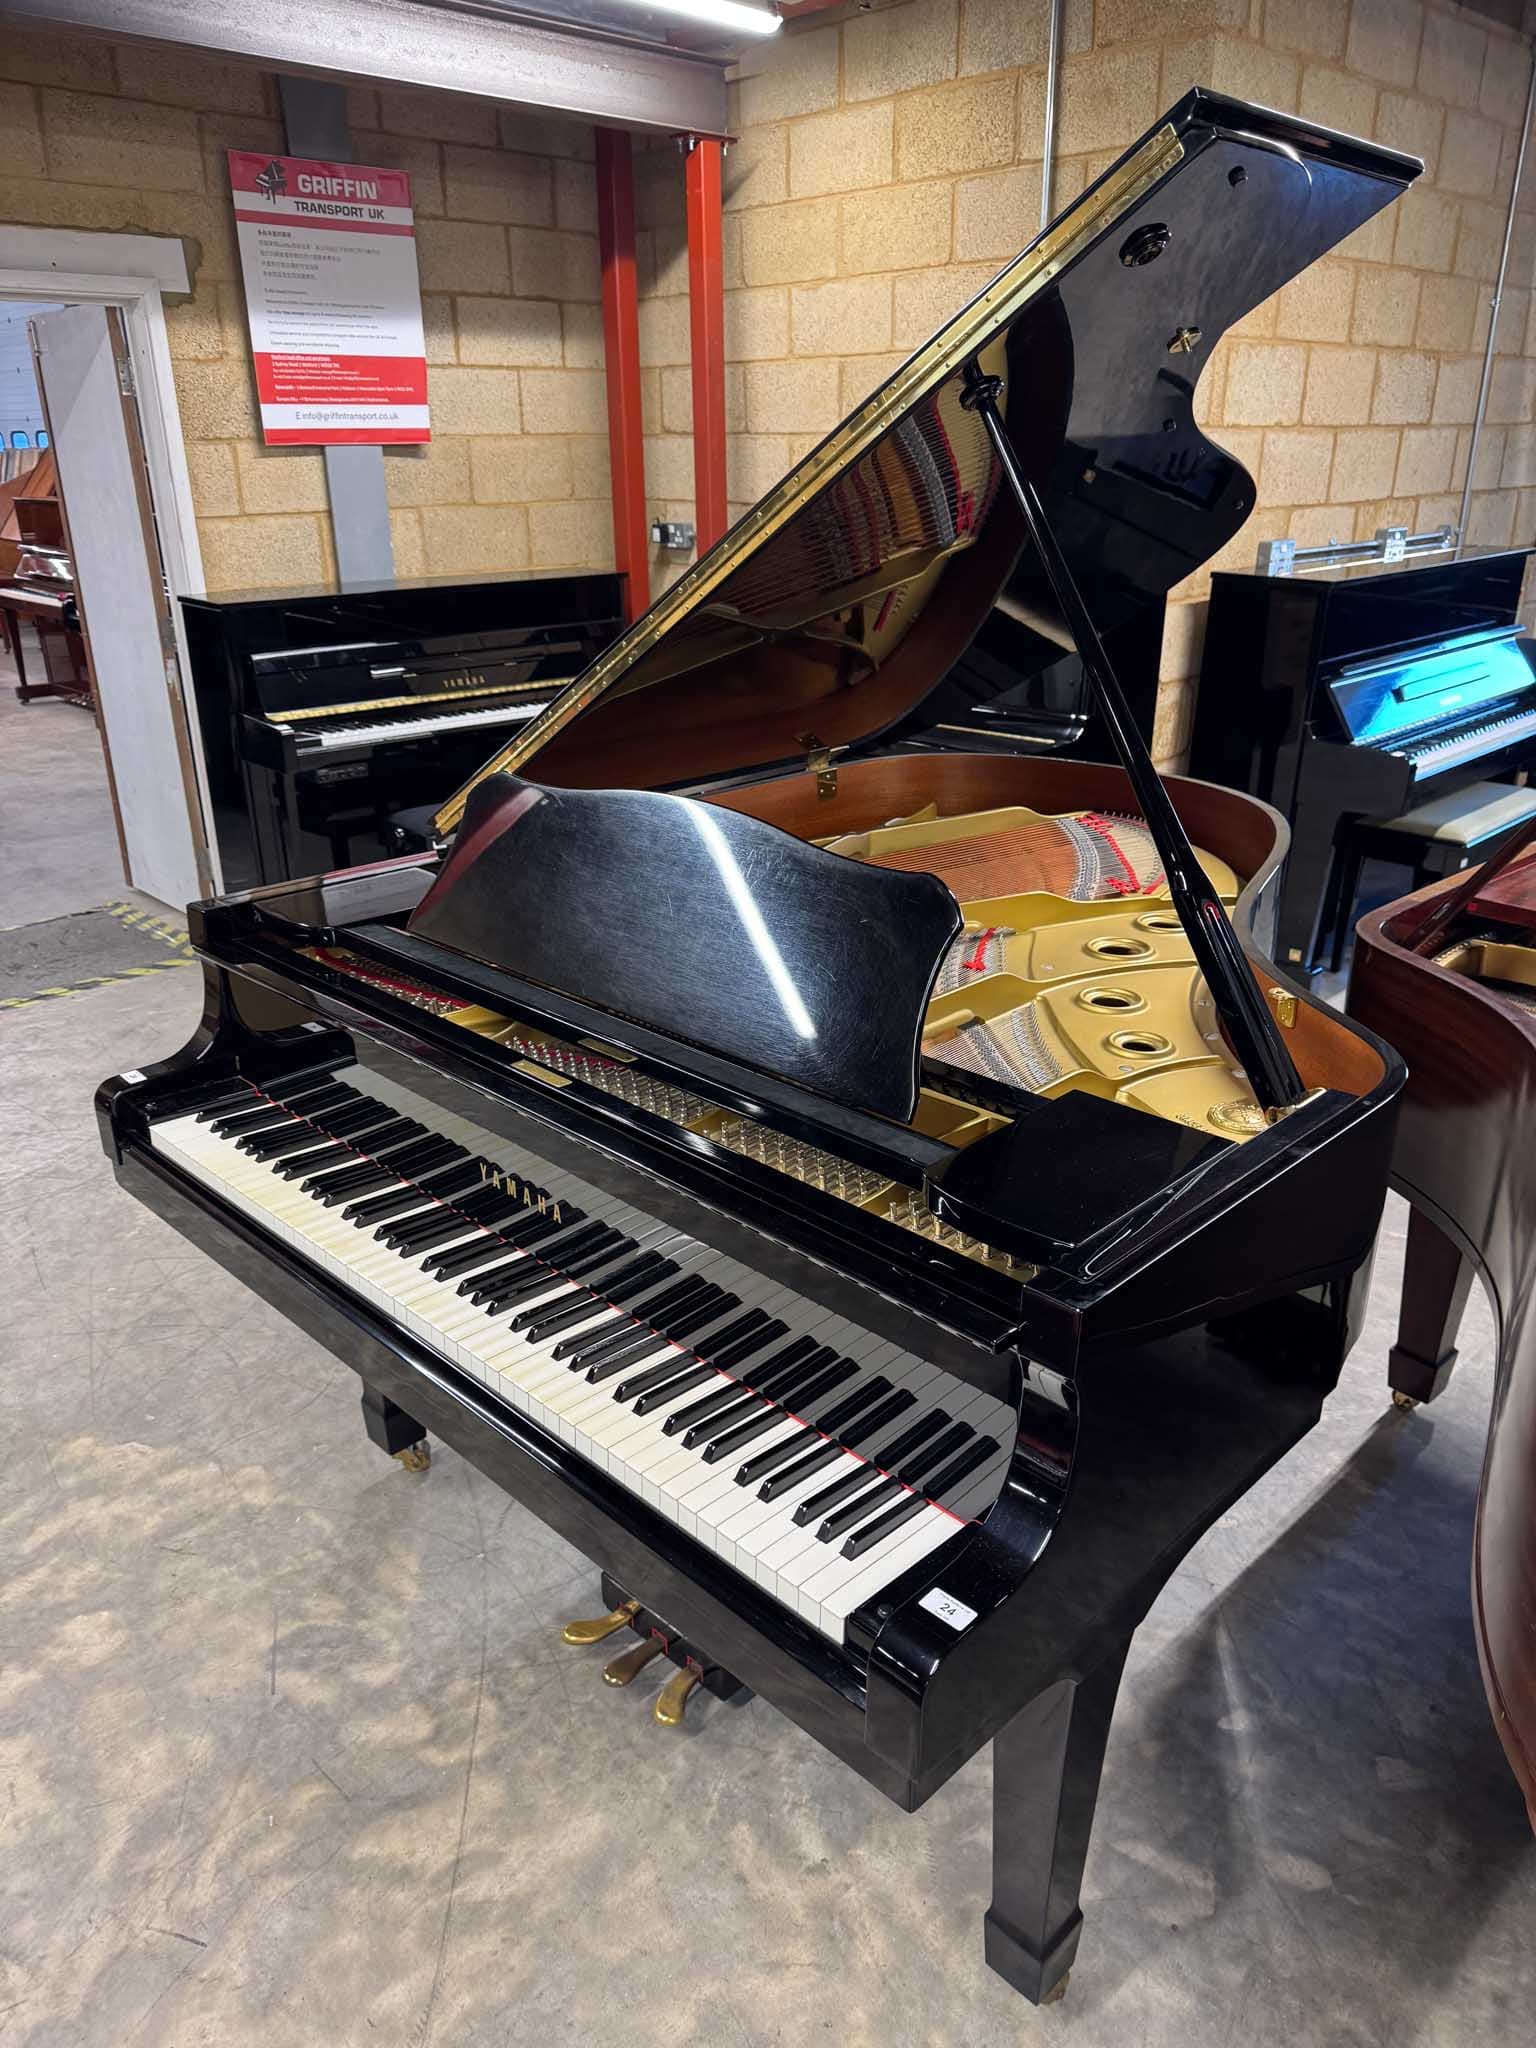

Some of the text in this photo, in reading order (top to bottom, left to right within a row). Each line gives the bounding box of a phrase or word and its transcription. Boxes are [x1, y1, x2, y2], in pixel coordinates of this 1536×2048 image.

[297, 174, 378, 200] GRIFFIN
[294, 200, 385, 220] TRANSPORT UK
[479, 1162, 562, 1225] YAMAHA
[940, 1603, 957, 1615] 24
